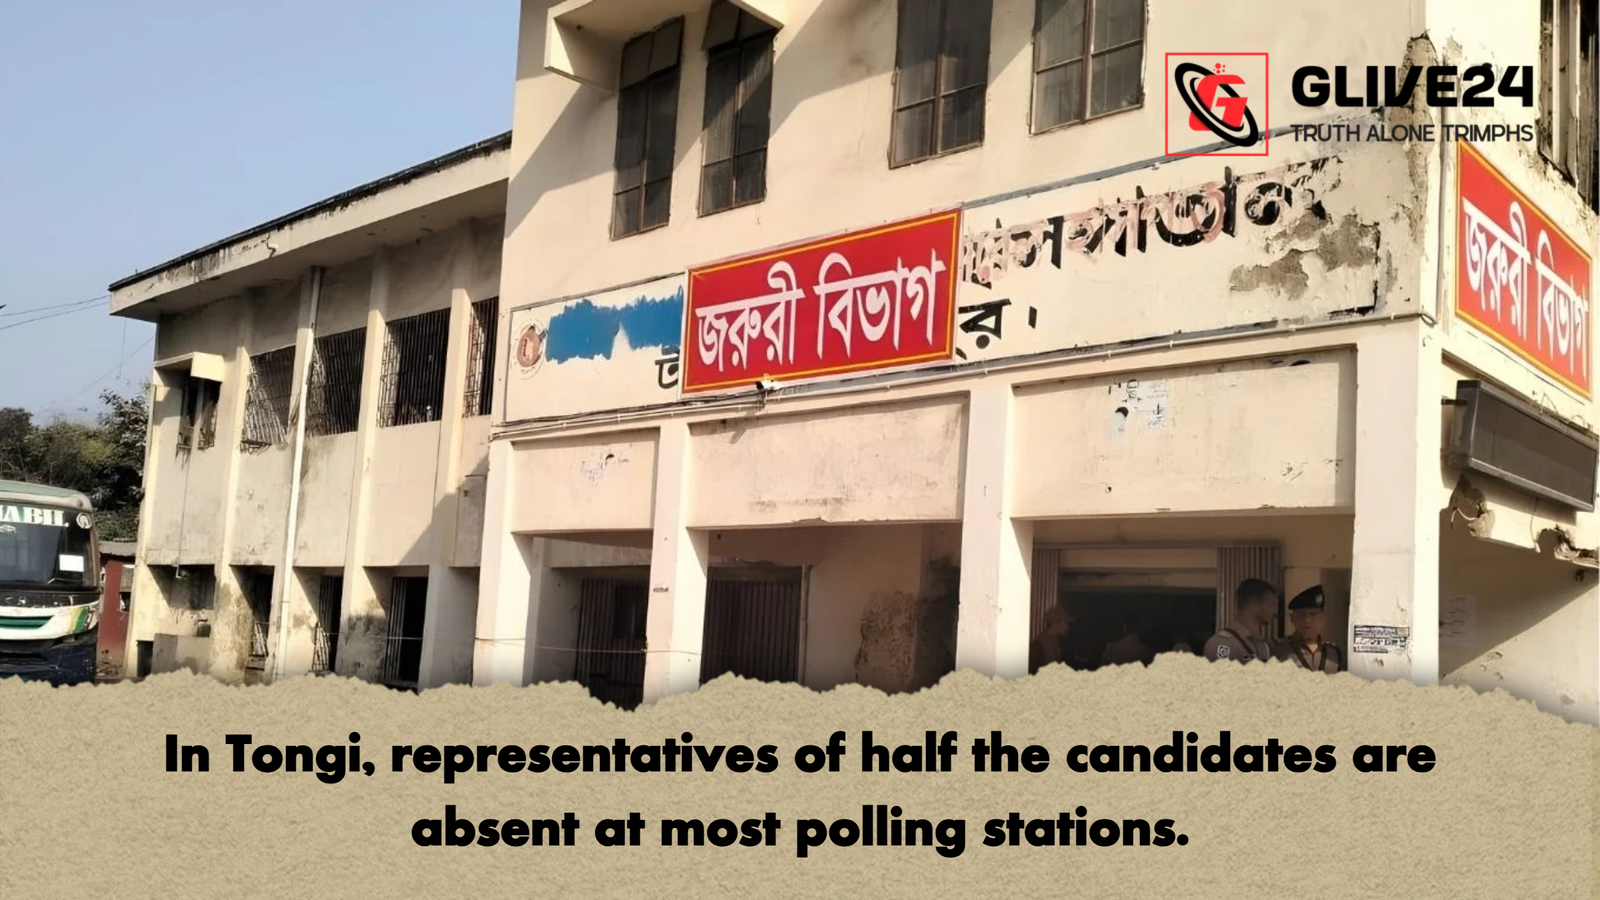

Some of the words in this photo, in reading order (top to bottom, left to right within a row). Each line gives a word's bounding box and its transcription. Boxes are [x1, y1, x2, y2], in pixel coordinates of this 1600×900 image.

[694, 260, 806, 372] জরুরী
[813, 247, 947, 360] বিভাগ
[1534, 228, 1589, 383] বিভাগ
[0, 505, 70, 528] ABIL
